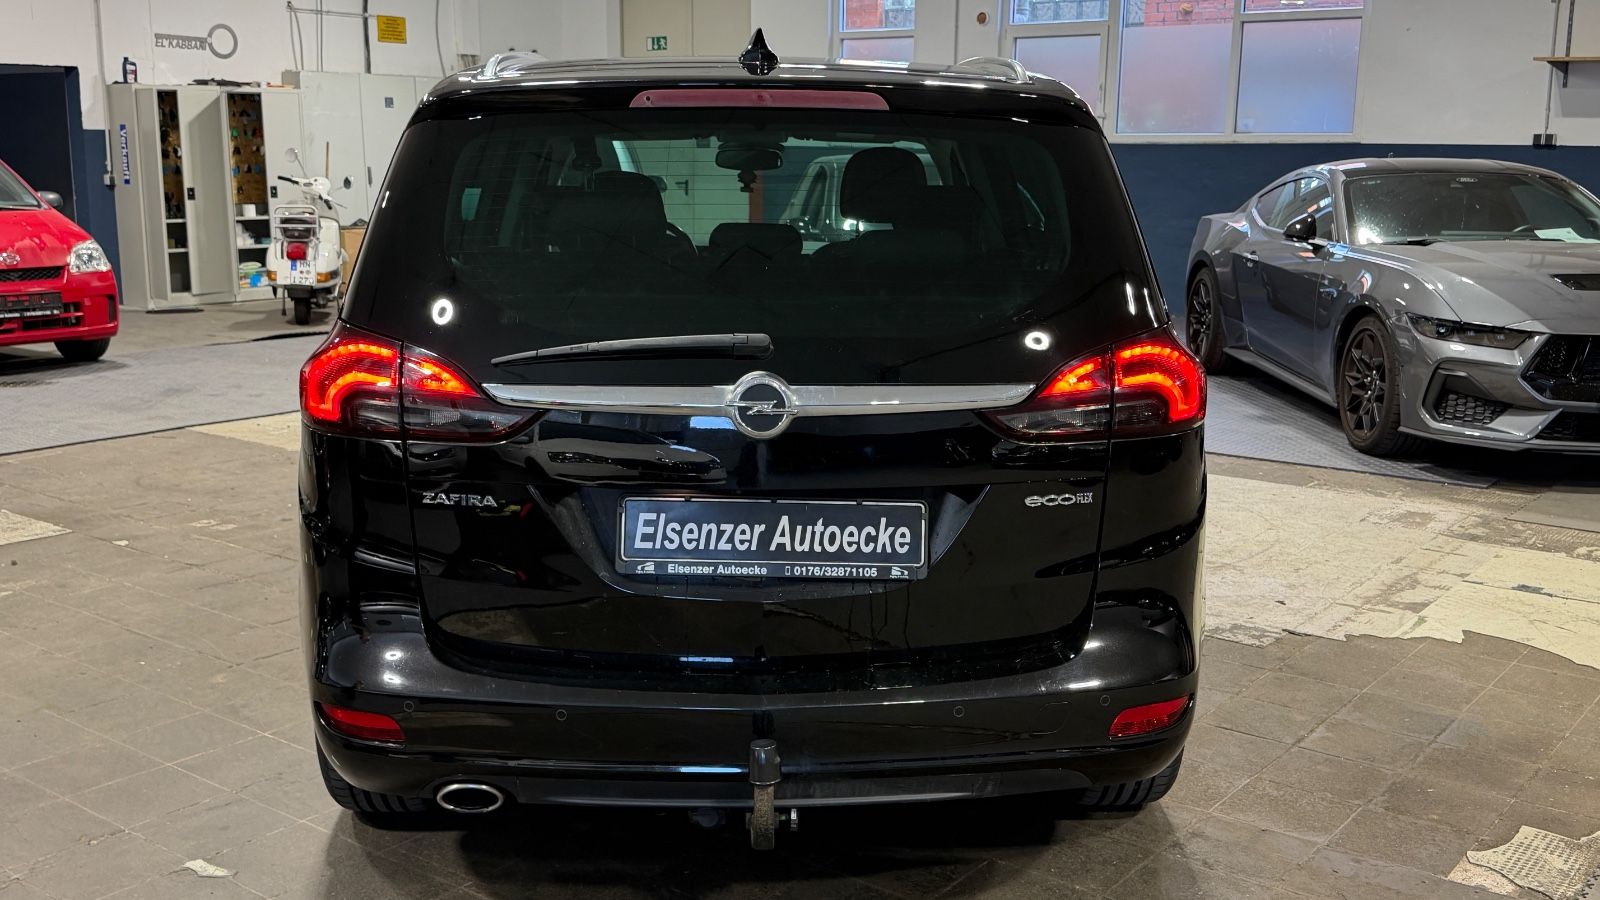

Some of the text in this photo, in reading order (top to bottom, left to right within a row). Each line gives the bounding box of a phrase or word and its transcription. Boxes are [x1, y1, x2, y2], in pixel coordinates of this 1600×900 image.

[120, 129, 130, 180] Verkauft
[422, 492, 498, 507] ZAFIRA
[634, 512, 911, 554] Elsenzer Autoecke
[667, 563, 878, 577] Elsenzer Autoecke 0176/32871105
